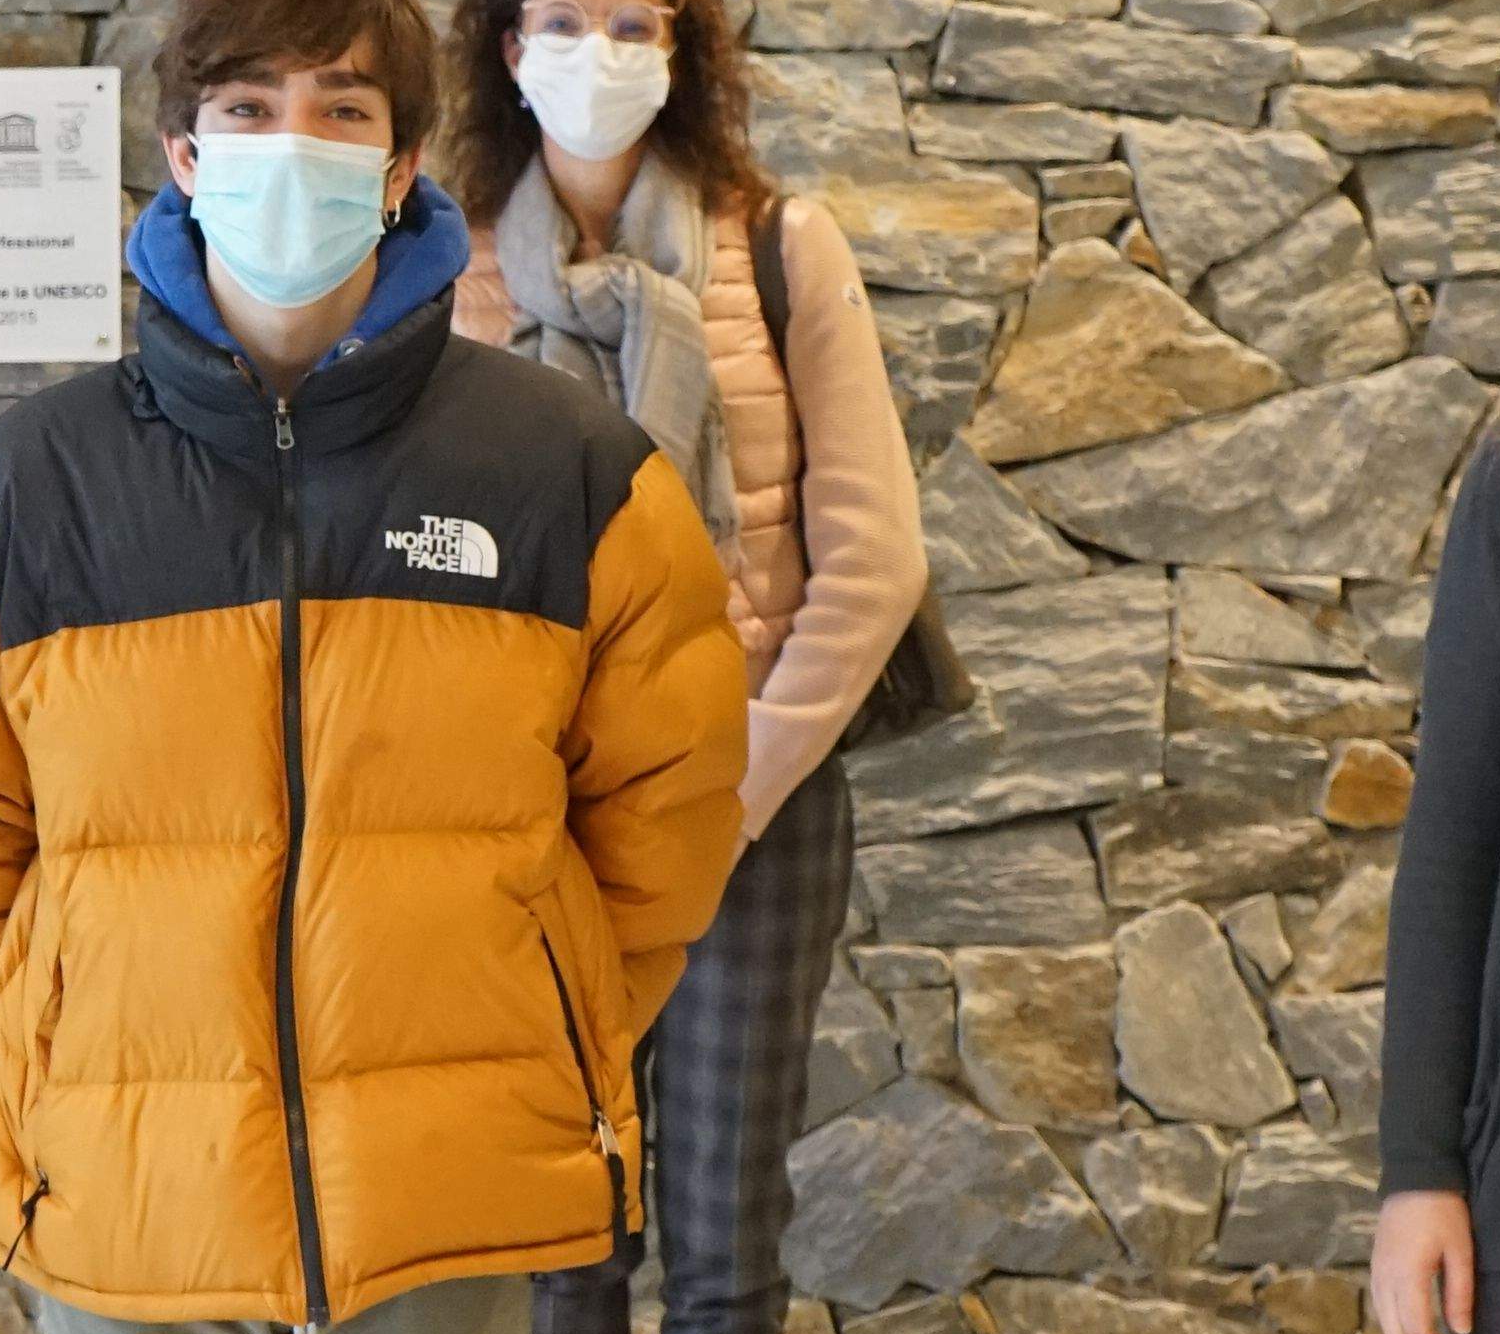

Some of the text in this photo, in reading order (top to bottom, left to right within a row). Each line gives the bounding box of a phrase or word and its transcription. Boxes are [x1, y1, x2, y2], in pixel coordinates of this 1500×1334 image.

[14, 285, 29, 300] la
[33, 283, 108, 301] UNESCO
[419, 514, 463, 536] THE
[384, 530, 461, 556] NORTH
[406, 552, 461, 574] FACE
